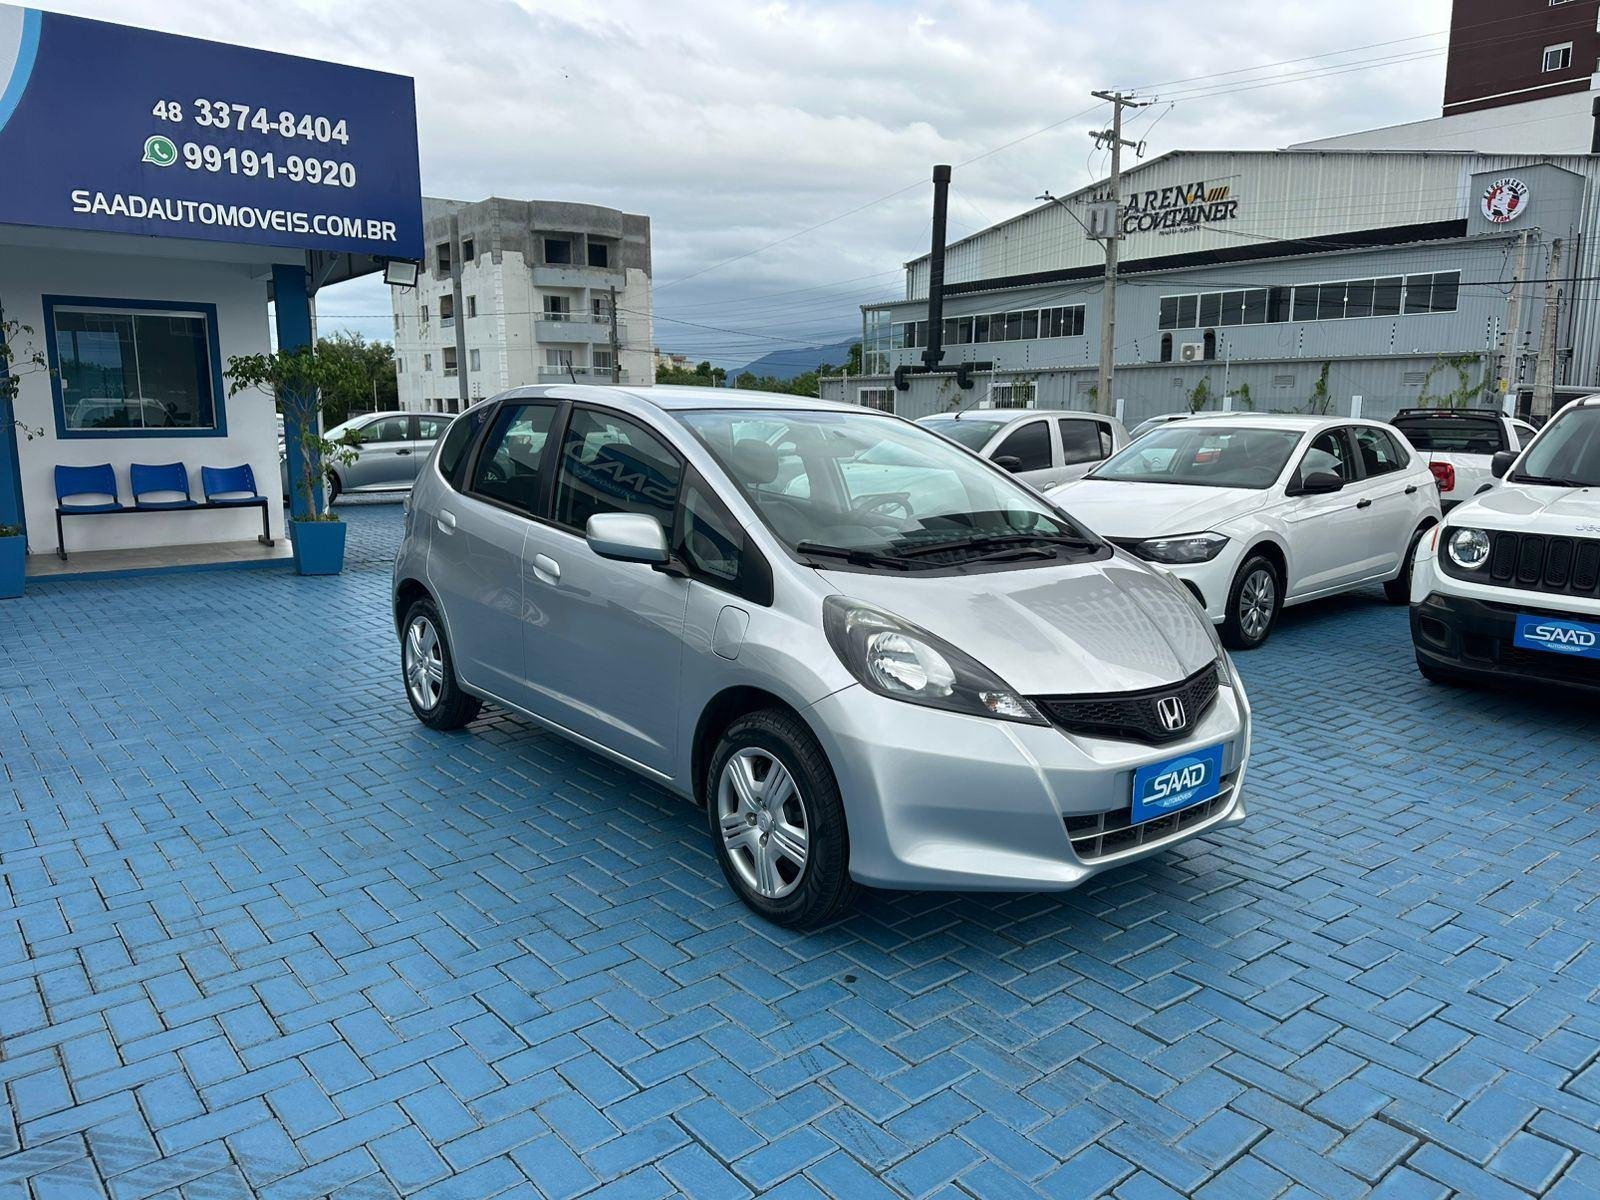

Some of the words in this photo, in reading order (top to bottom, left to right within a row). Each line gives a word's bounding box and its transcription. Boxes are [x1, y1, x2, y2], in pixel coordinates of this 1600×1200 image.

[152, 100, 183, 123] 48
[194, 98, 349, 145] 3374-8404
[183, 142, 356, 188] 99191-9920
[72, 190, 397, 241] SAADAUTOMOVEIS.COM.BR
[1124, 181, 1207, 216] ARENA
[1124, 200, 1238, 234] CONTAINER
[1524, 626, 1596, 646] SAAD
[1142, 763, 1205, 804] SAAD
